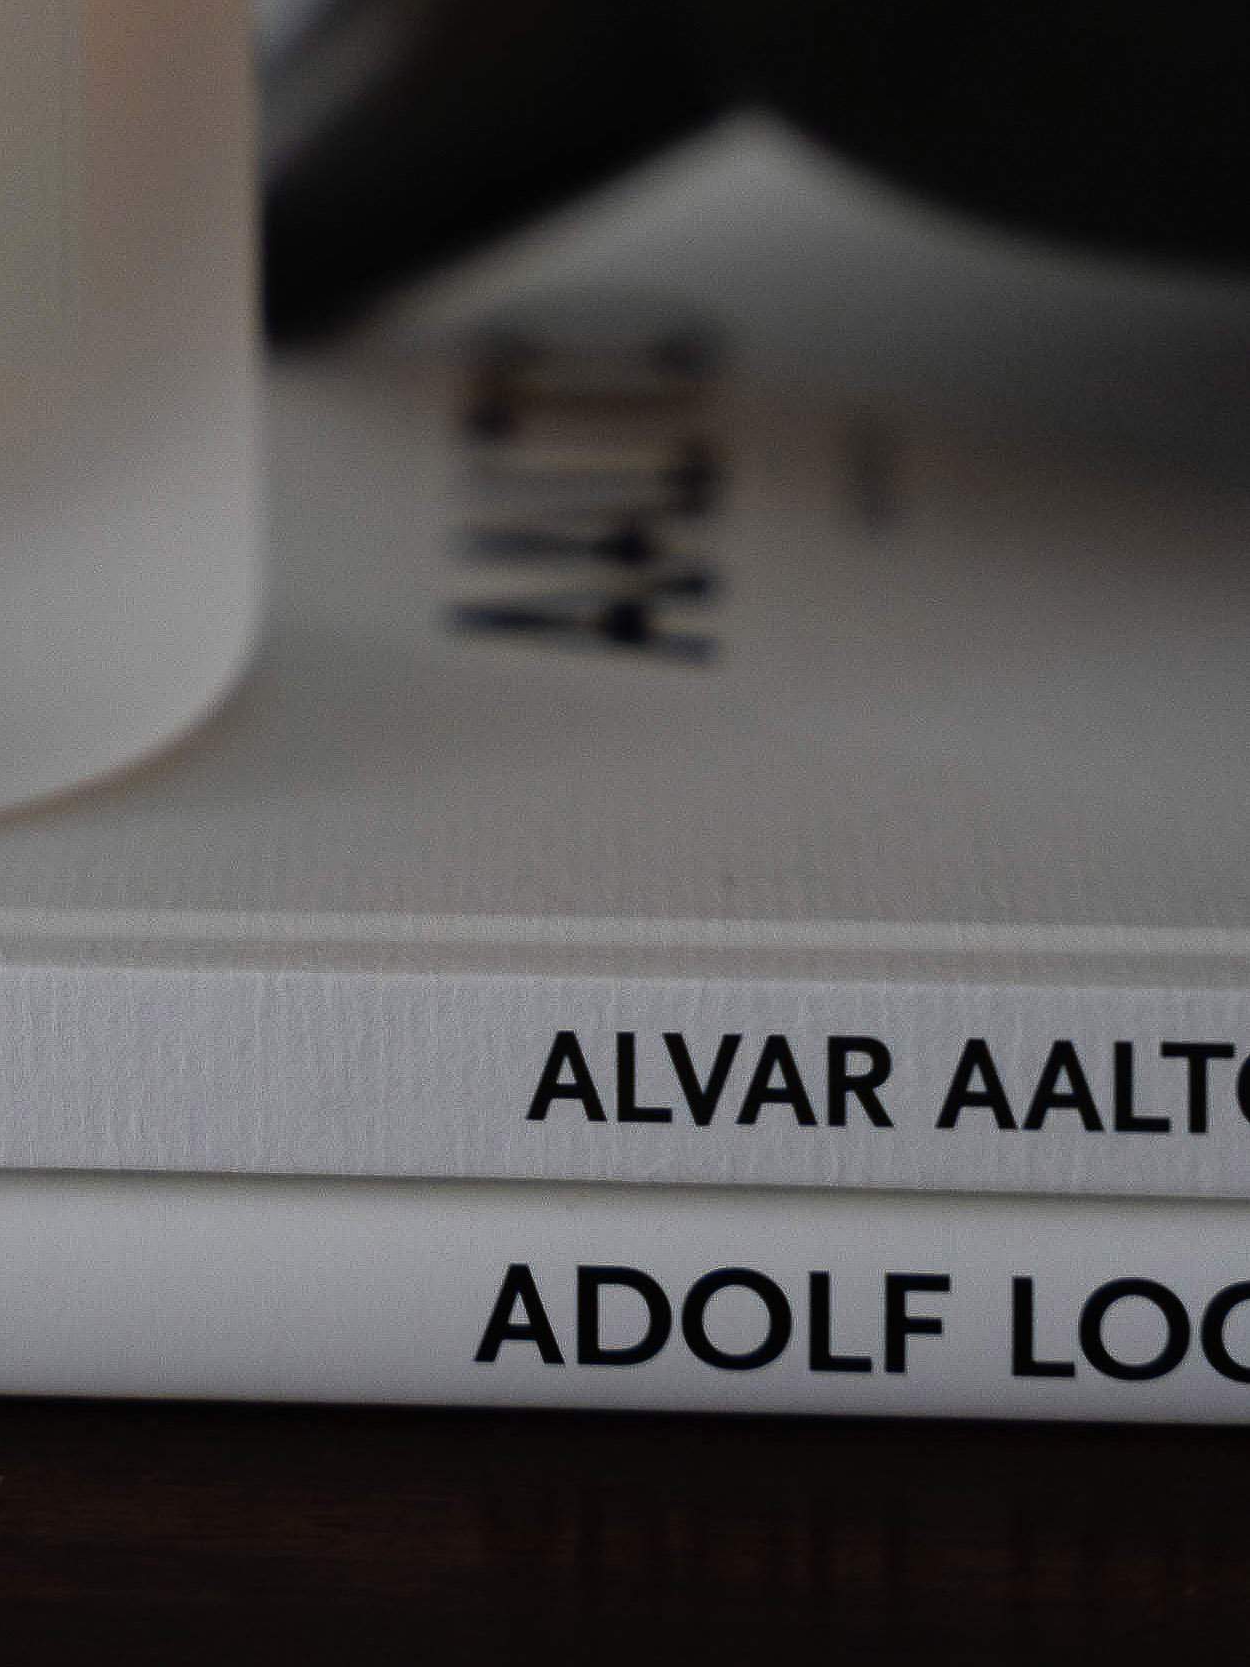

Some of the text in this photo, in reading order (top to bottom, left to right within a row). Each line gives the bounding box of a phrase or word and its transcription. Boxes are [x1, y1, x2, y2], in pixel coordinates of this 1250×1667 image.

[524, 1029, 1250, 1135] ALVAR AALT
[472, 1262, 952, 1376] ADOLF
